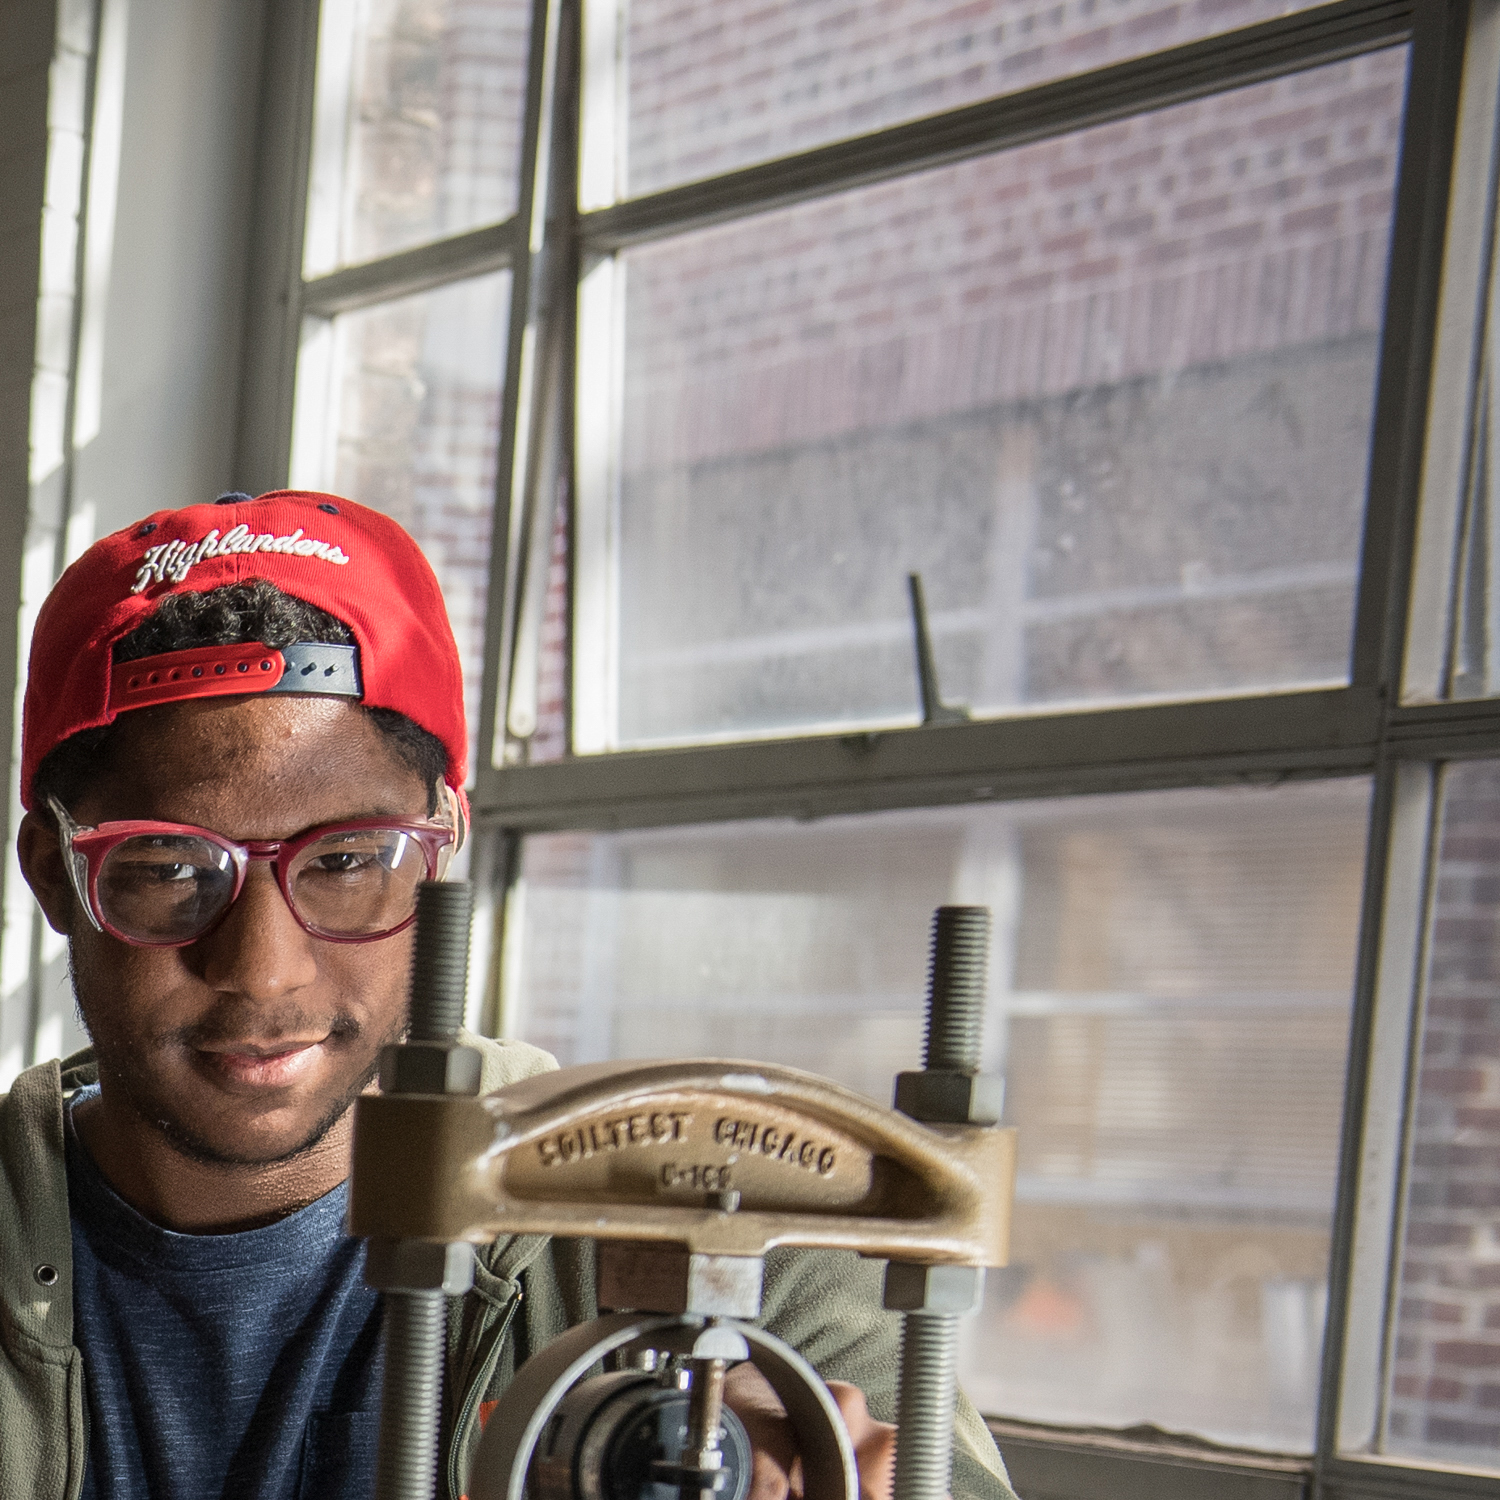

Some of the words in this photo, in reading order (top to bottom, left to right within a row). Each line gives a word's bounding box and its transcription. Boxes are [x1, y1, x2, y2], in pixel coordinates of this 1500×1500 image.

[130, 523, 350, 595] Highlanders
[537, 1111, 695, 1168] SOILTEST
[713, 1115, 837, 1179] CHICAGO
